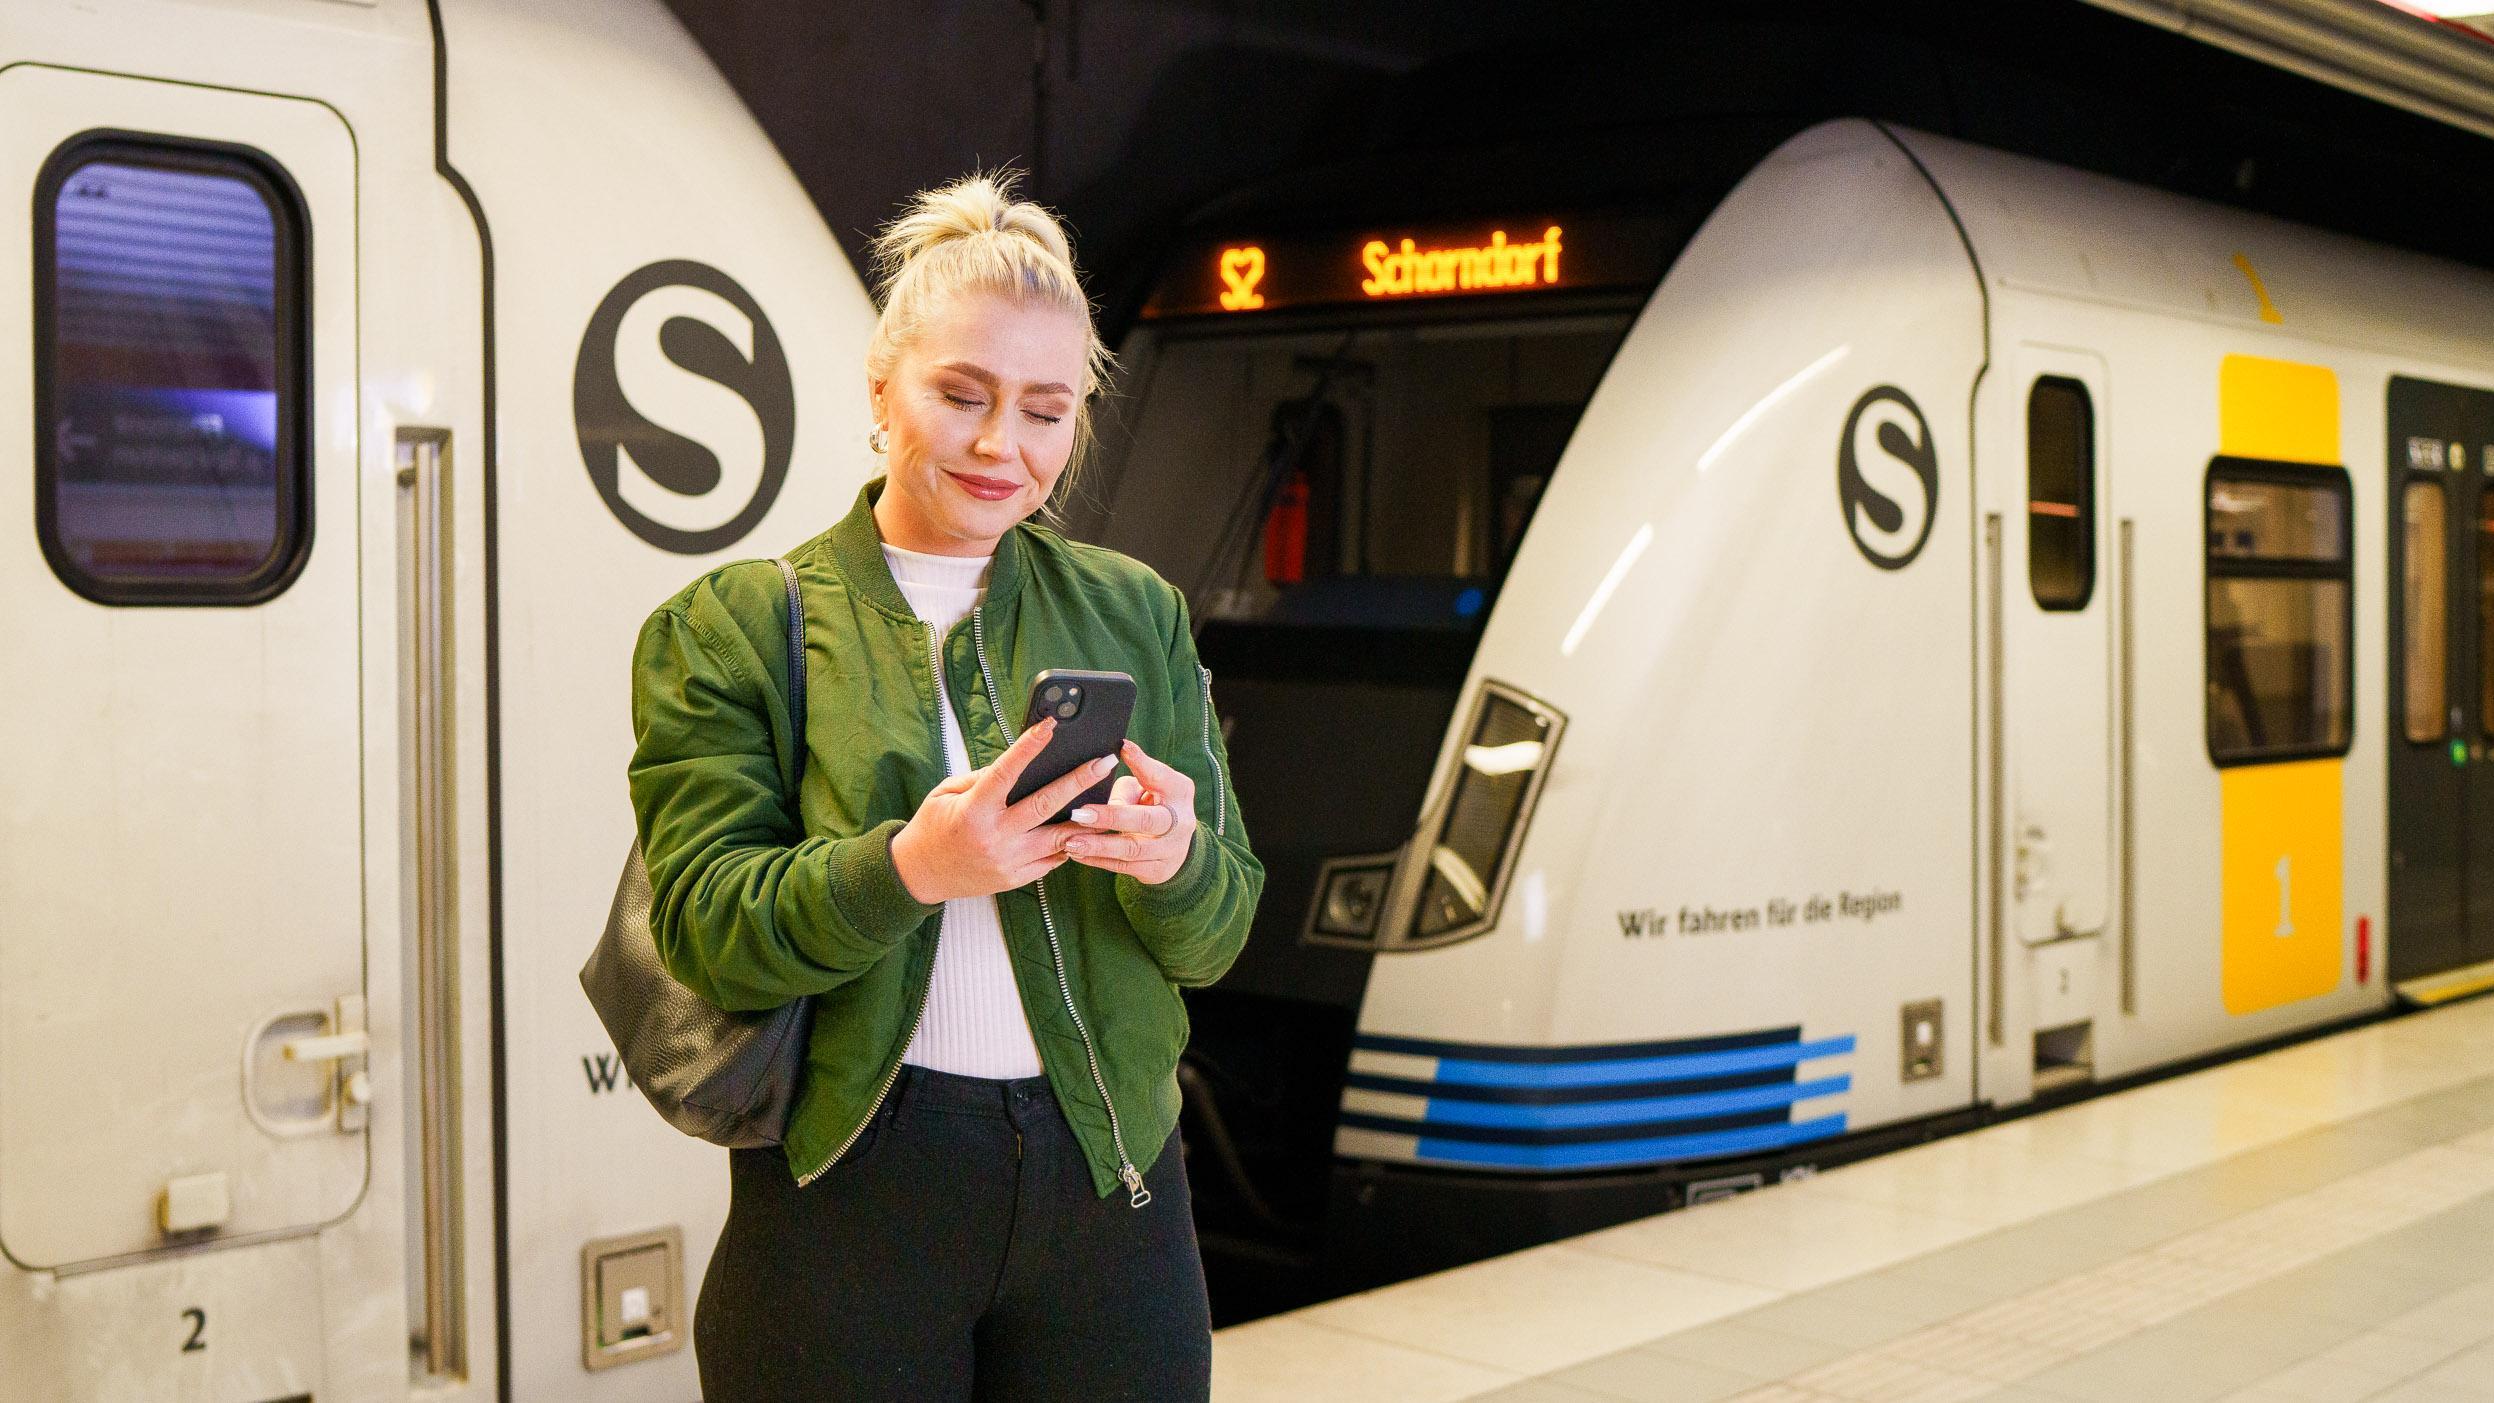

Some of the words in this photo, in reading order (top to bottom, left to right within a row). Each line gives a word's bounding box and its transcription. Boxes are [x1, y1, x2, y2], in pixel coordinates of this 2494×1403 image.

[1362, 226, 1563, 297] Schorndorf
[614, 284, 766, 532] S
[1854, 398, 1928, 558] S
[1617, 908, 1667, 936] Wir
[1678, 905, 1760, 934] fahren
[1766, 899, 1797, 926] für
[1804, 893, 1832, 923] die
[1839, 890, 1901, 921] Region
[2274, 854, 2295, 937] 1
[582, 1054, 634, 1093] W
[181, 1307, 206, 1354] 2
